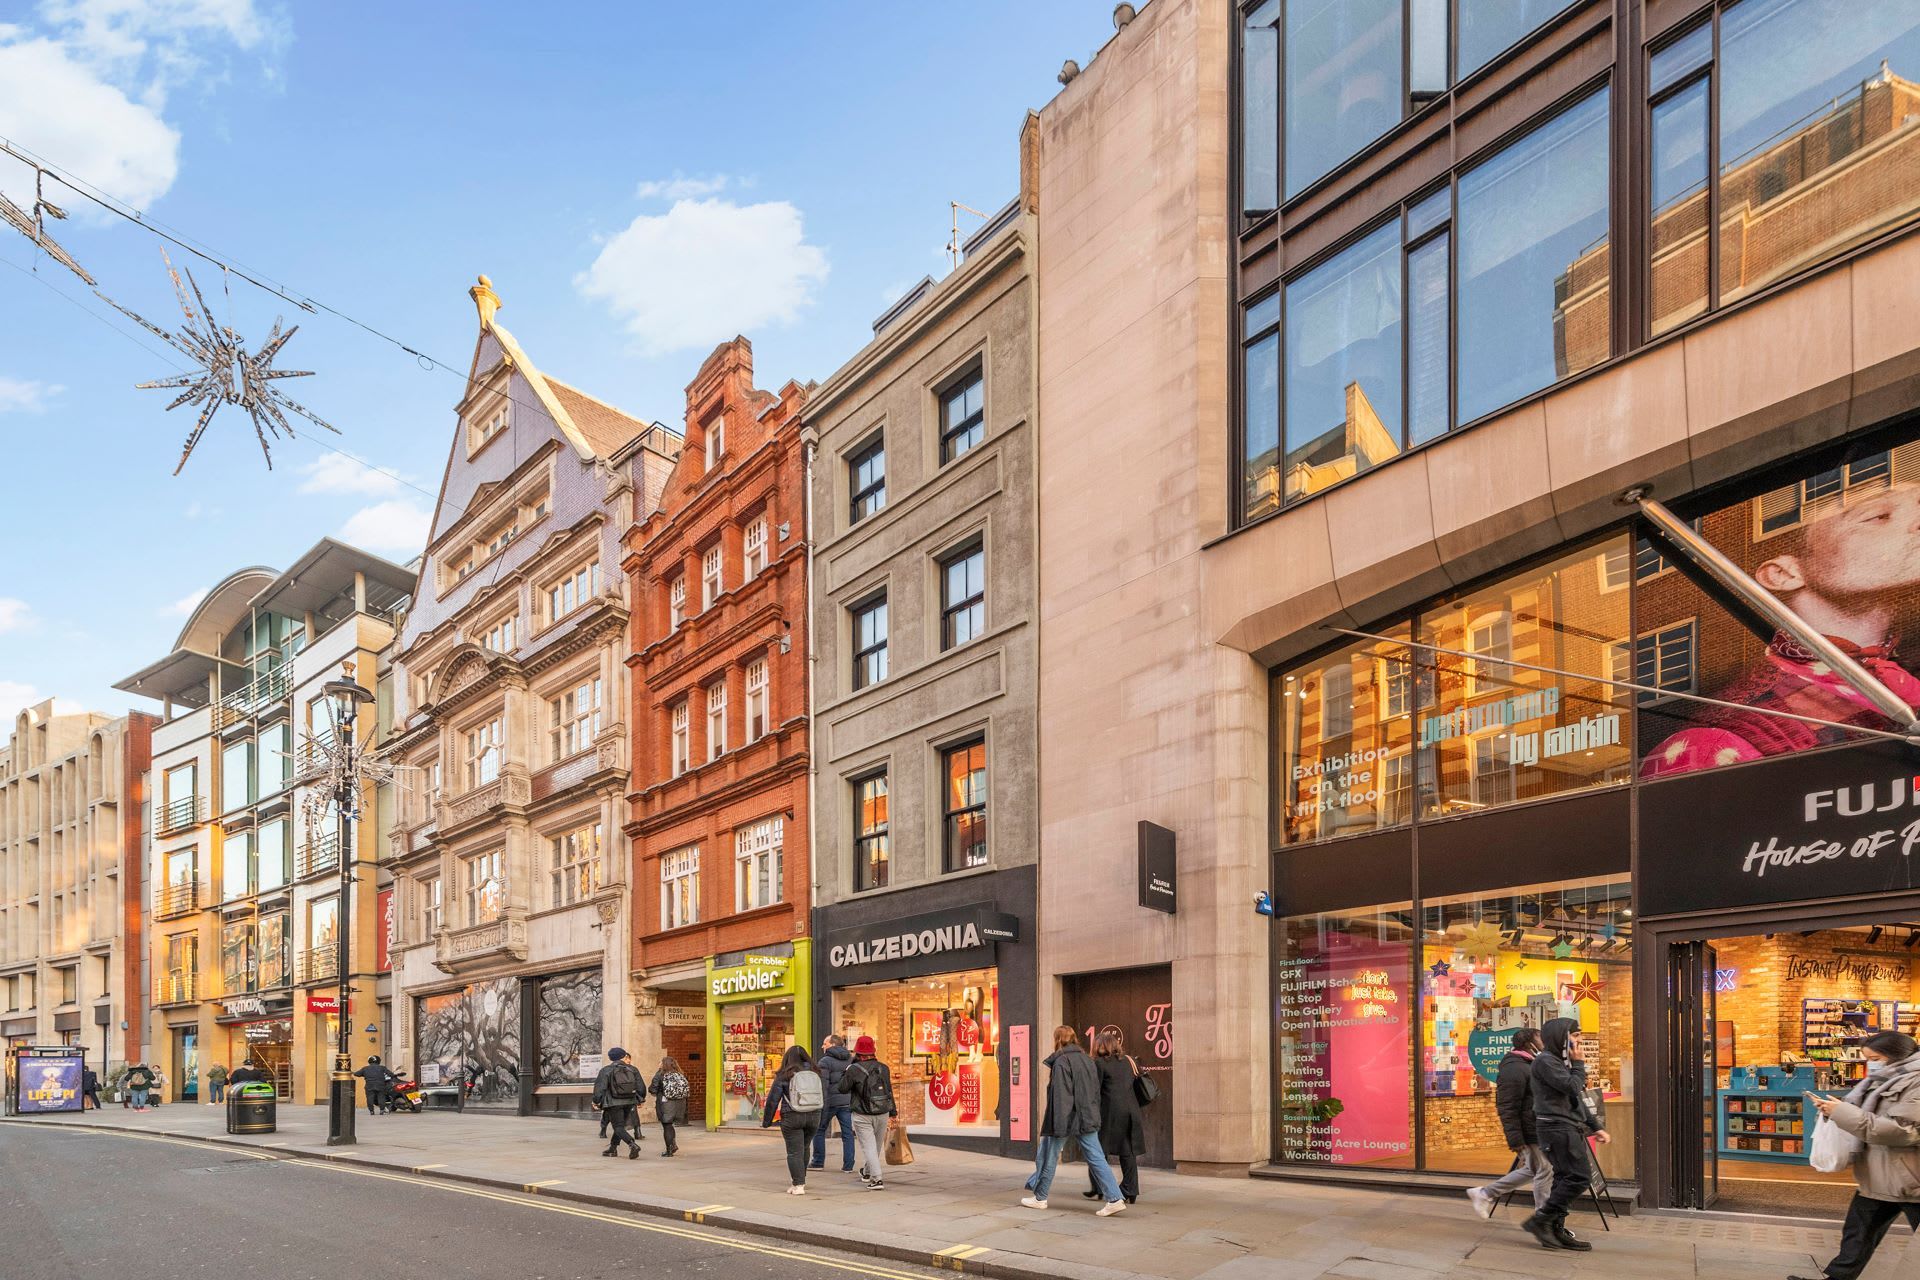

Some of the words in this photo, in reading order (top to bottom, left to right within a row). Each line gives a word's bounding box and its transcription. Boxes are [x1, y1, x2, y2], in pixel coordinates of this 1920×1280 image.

[1421, 687, 1559, 750] performance
[1510, 732, 1539, 767] by
[1544, 713, 1620, 758] rankin
[1293, 746, 1390, 780] Exhibition
[1309, 780, 1333, 795] on
[1338, 771, 1372, 788] the
[1297, 797, 1334, 817] first
[1339, 789, 1384, 808] floo
[1742, 837, 1846, 877] House
[983, 928, 1014, 937] CALZEDONIA
[829, 922, 981, 968] CALZEDONIA
[749, 956, 788, 966] scribbler
[1296, 958, 1314, 966] floor
[1280, 969, 1302, 980] GFX
[711, 968, 779, 996] scribbler
[1280, 980, 1327, 993] FUJIFILM
[1280, 995, 1296, 1005] Kit
[1297, 994, 1322, 1005] Stop
[1281, 1008, 1300, 1018] The
[1302, 1005, 1342, 1017] Gallery
[730, 1022, 754, 1035] SALE
[1281, 1021, 1311, 1032] Open
[934, 1075, 956, 1097] 50
[1282, 1080, 1331, 1088] Cameras
[27, 1090, 52, 1101] LIFE
[936, 1097, 952, 1105] OFF
[1283, 1092, 1319, 1101] Lenses
[1284, 1125, 1303, 1134] The
[1305, 1124, 1341, 1135] Studio
[1284, 1138, 1304, 1147] The
[1306, 1139, 1333, 1149] Long
[1335, 1139, 1361, 1149] Acre
[1363, 1140, 1407, 1152] Lounge
[1284, 1151, 1344, 1163] Workshops
